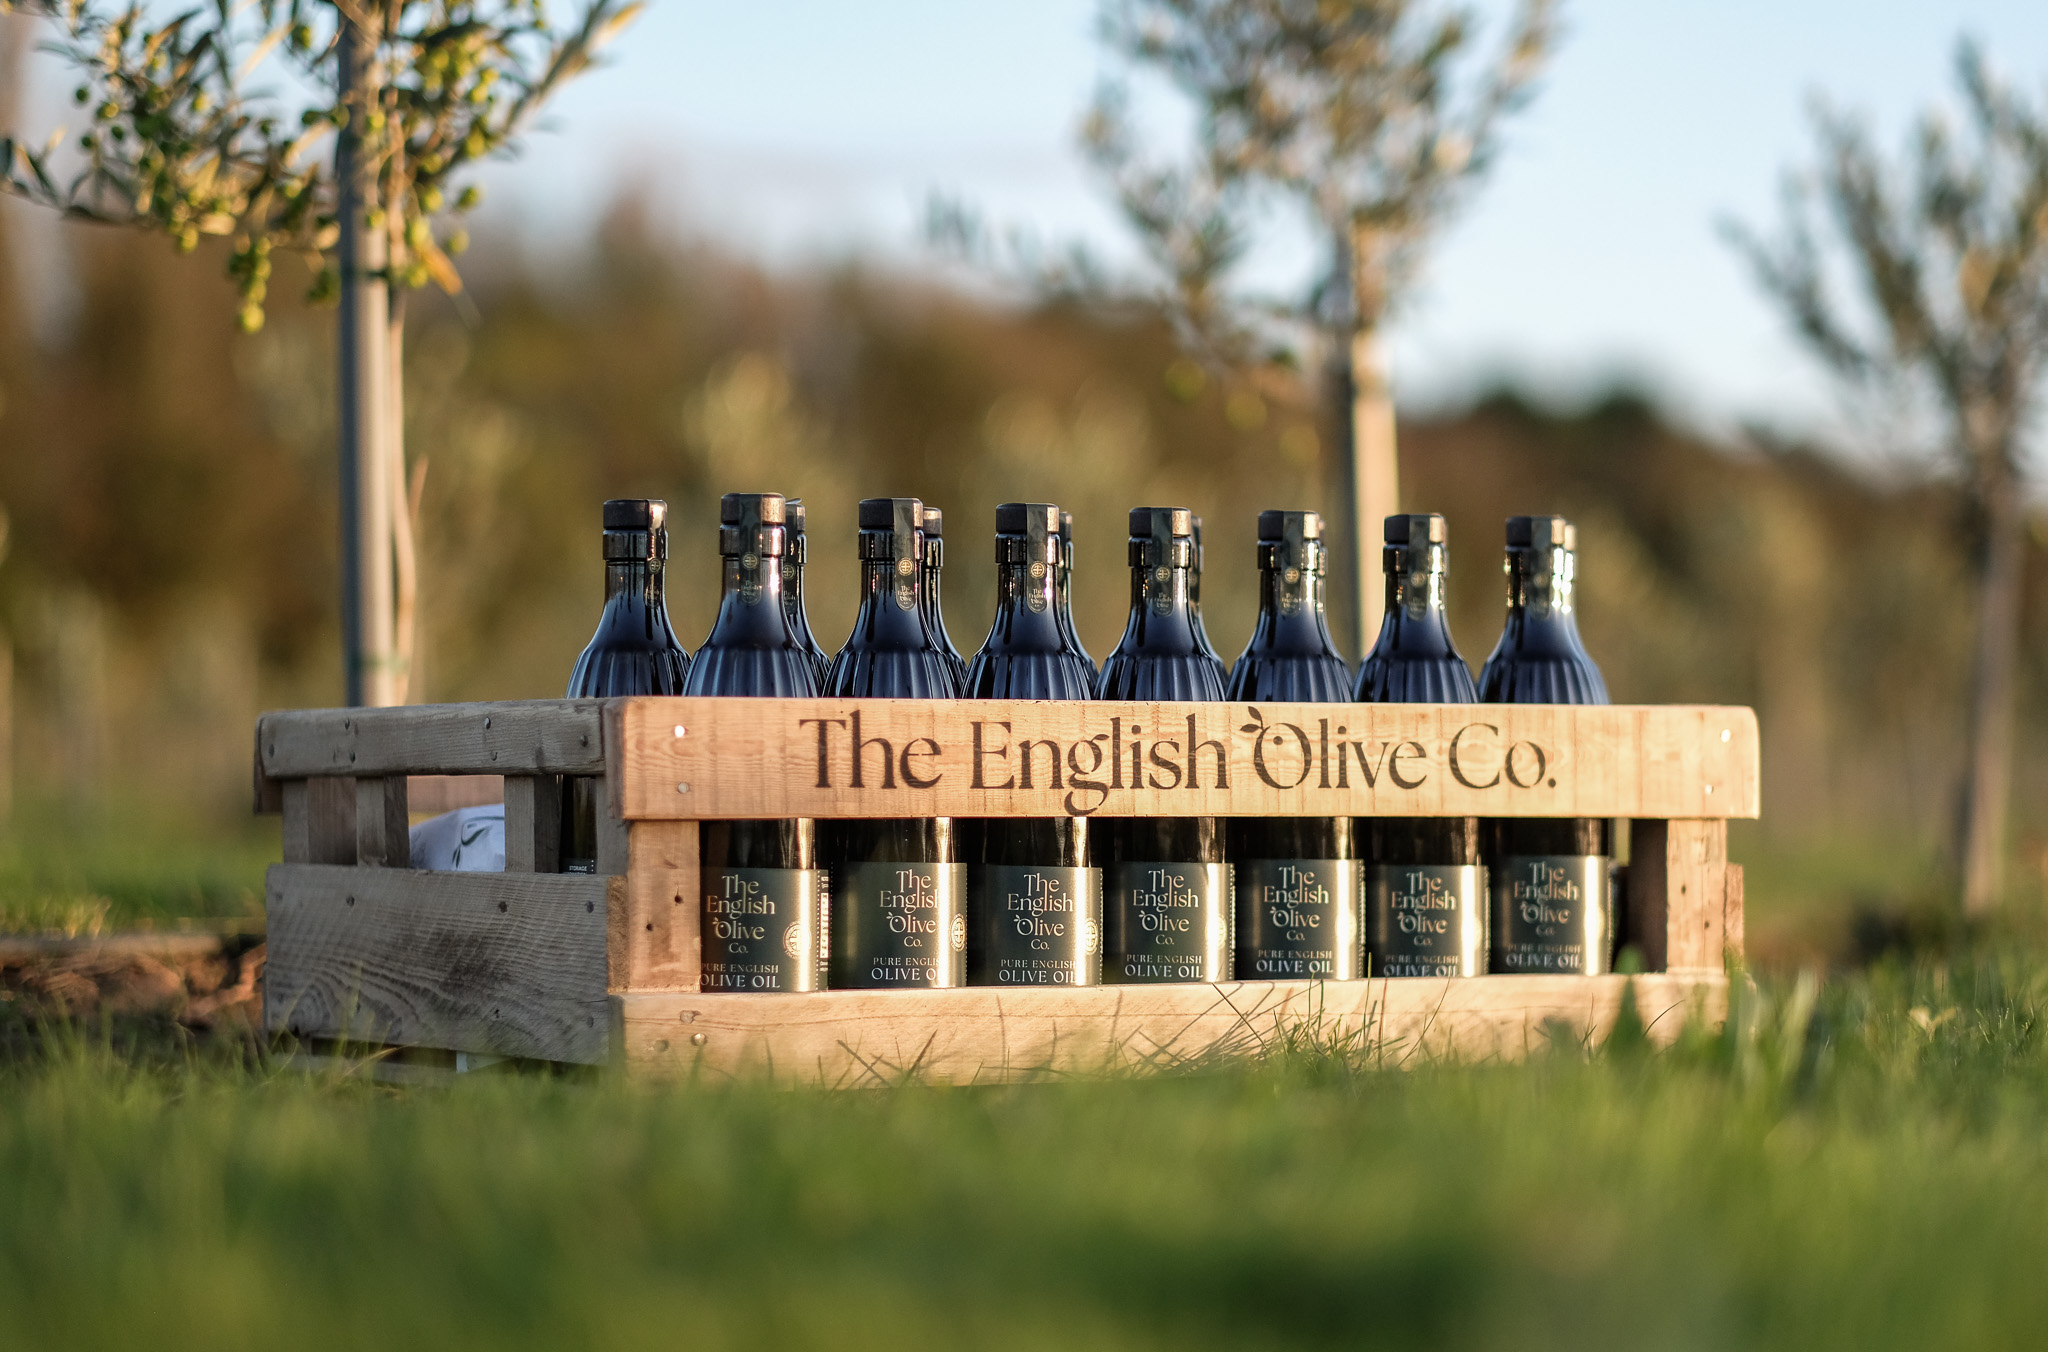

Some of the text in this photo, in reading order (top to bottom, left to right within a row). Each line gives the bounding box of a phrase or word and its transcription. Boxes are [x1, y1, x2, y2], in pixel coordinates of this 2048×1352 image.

[799, 706, 1557, 815] The English Olive Co.
[721, 874, 760, 898] The
[896, 869, 931, 893] The
[1024, 872, 1060, 896] The
[1148, 869, 1185, 892] The
[1279, 865, 1315, 889] The
[1406, 871, 1442, 895] The
[706, 895, 776, 919] English
[1007, 892, 1073, 917] English
[1133, 889, 1199, 912] English
[1264, 885, 1329, 909] English
[1391, 889, 1457, 914] English
[889, 913, 937, 934] Olive
[1015, 916, 1064, 937] Olive
[1141, 912, 1190, 932] Olive
[1271, 908, 1320, 928] Olive
[1399, 913, 1448, 934] Olive
[714, 919, 765, 940] Olive
[1155, 934, 1175, 945] Co.
[1286, 930, 1306, 941] Co.
[728, 943, 749, 954] Co.
[904, 936, 922, 947] Co.
[1030, 938, 1050, 950] Co.
[873, 957, 939, 966] PURE ENGLIS
[1001, 959, 1076, 969] PURE ENGLISH
[1126, 954, 1202, 964] PURE ENGLISH
[1257, 950, 1332, 959] PURE ENGLISH
[730, 964, 779, 974] ENGLISH
[871, 967, 921, 980] OLIVE
[999, 969, 1047, 983] OLIVE
[1125, 964, 1203, 979] OLIVE OIL
[1256, 960, 1334, 974] OLIVE OIL
[1383, 964, 1430, 977] OLIVE
[700, 973, 781, 989] OLIVE OIL
